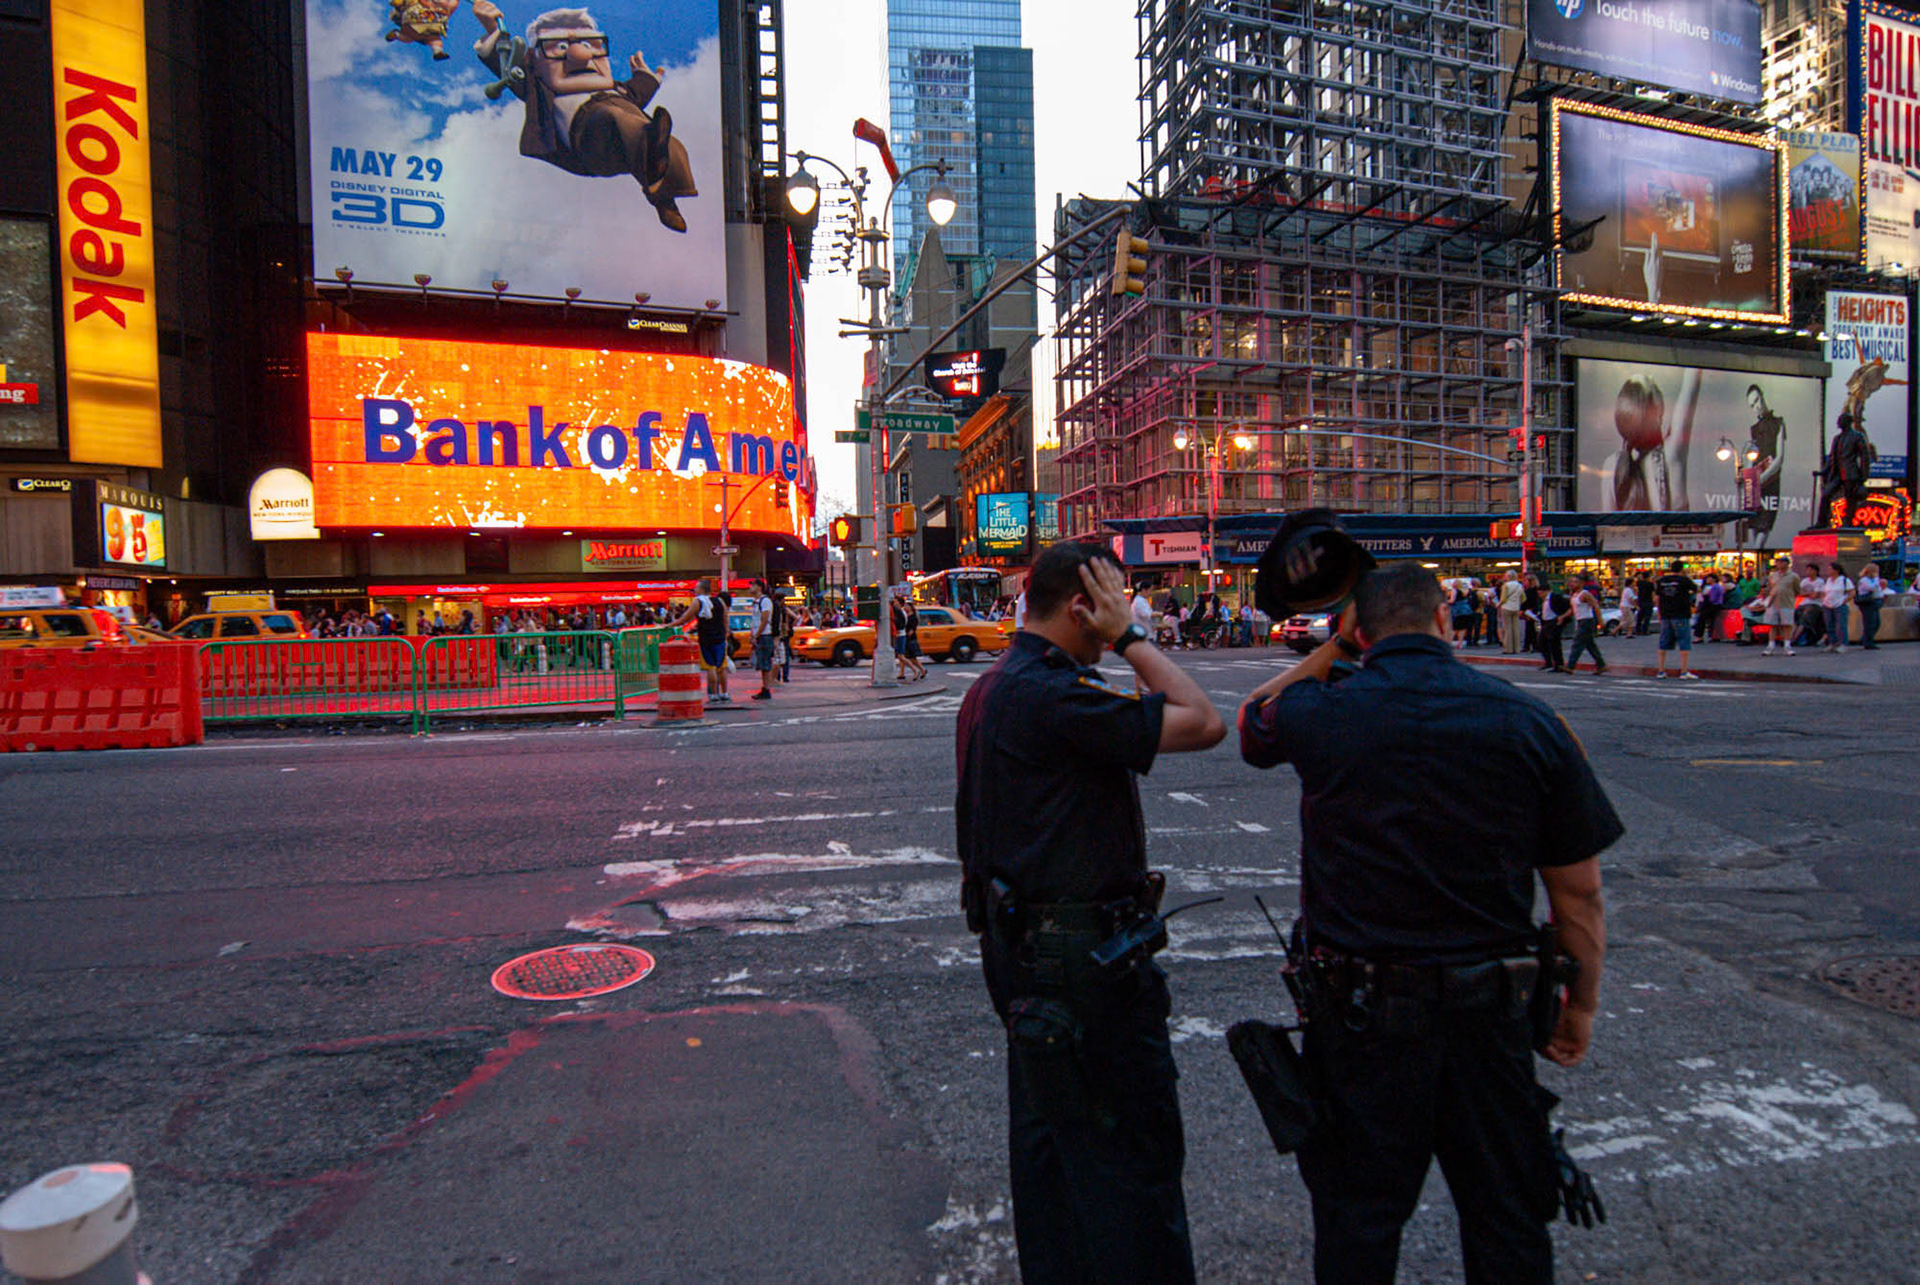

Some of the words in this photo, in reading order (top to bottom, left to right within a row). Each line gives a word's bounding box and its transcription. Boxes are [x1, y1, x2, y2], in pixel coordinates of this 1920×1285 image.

[1596, 0, 1638, 23] Touch
[1641, 9, 1666, 29] the
[1666, 12, 1710, 41] future
[1868, 22, 1920, 100] BILL
[1719, 74, 1758, 95] Windows
[1779, 131, 1815, 145] BEST
[1820, 133, 1856, 149] PLAY
[330, 147, 397, 178] MAY
[406, 155, 443, 182] 29
[63, 66, 145, 331] Kodak
[330, 181, 387, 193] DISNEY
[390, 186, 445, 200] DIGITAL
[331, 191, 445, 229] 3D
[1789, 200, 1845, 233] AUGUST
[1837, 296, 1906, 325] HEIGHTS
[1856, 325, 1874, 338] TONY
[1878, 327, 1905, 340] AWARD
[1832, 339, 1856, 360] BEST
[1861, 340, 1906, 362] MUSICAL
[0, 387, 26, 402] ng
[361, 397, 573, 468] Bank
[585, 410, 663, 471] of
[880, 417, 940, 433] roadway
[99, 484, 163, 511] MARQUIS
[259, 498, 309, 511] Marriott
[1705, 493, 1779, 511] VIVINE
[1781, 497, 1811, 512] TAM
[989, 517, 1018, 527] LITTLE
[995, 507, 1012, 518] THE
[1853, 506, 1892, 527] OXY
[978, 525, 1028, 541] MERMAID
[584, 541, 663, 562] Marriott
[1149, 539, 1165, 556] T
[1162, 545, 1197, 554] TISHMAN
[1357, 539, 1412, 550] TFITTERS
[1441, 538, 1498, 550] AMERICAN
[1547, 537, 1592, 547] TFITTERS
